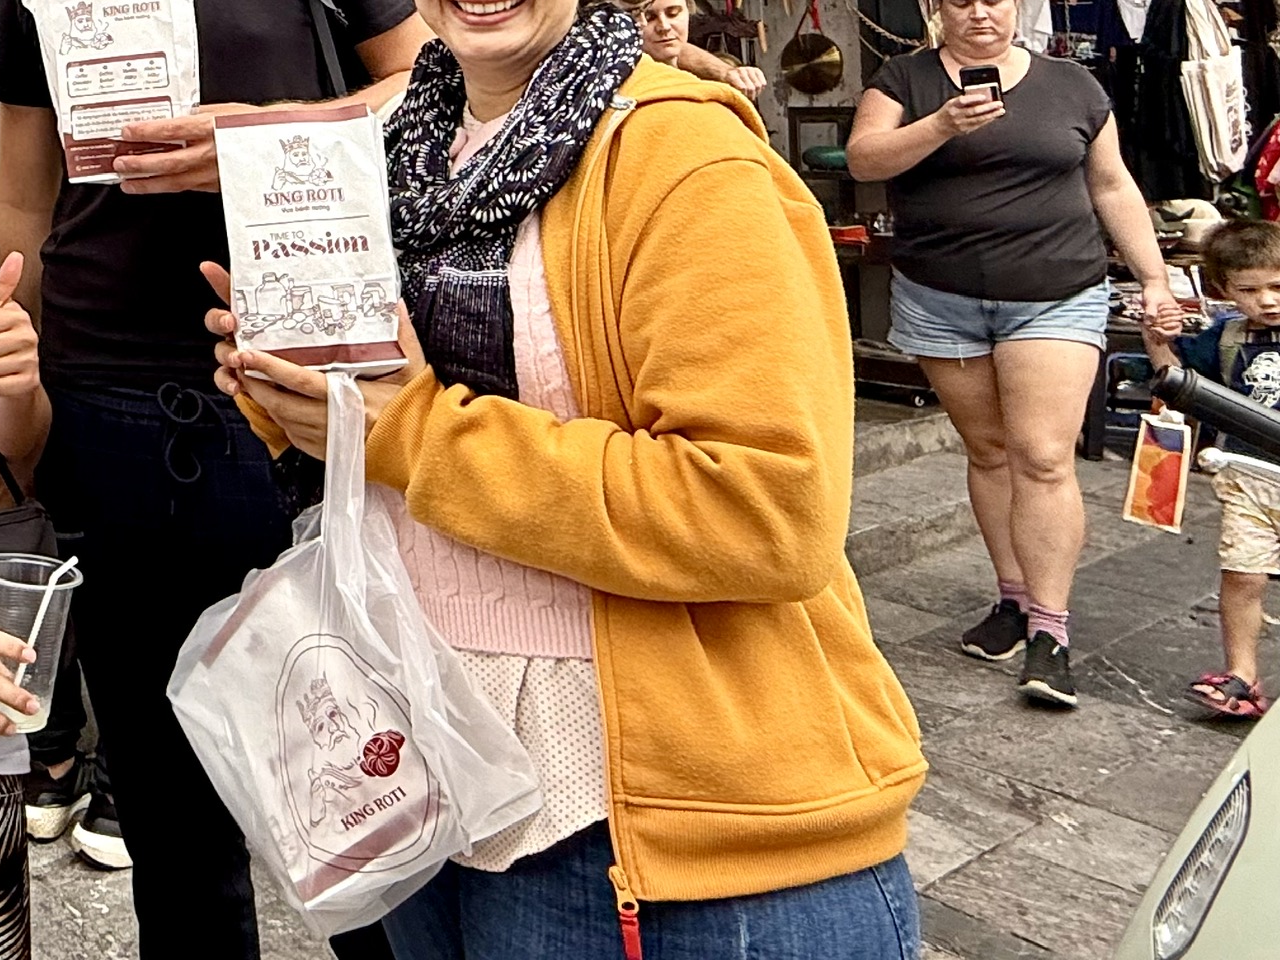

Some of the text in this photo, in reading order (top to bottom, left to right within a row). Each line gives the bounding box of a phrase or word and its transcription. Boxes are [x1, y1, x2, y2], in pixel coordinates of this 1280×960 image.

[103, 3, 130, 18] KING
[132, 1, 160, 14] ROTI
[263, 187, 346, 207] KING ROTI
[252, 231, 370, 260] Passion
[269, 230, 305, 241] TIME TO
[341, 786, 407, 831] KING ROTI
